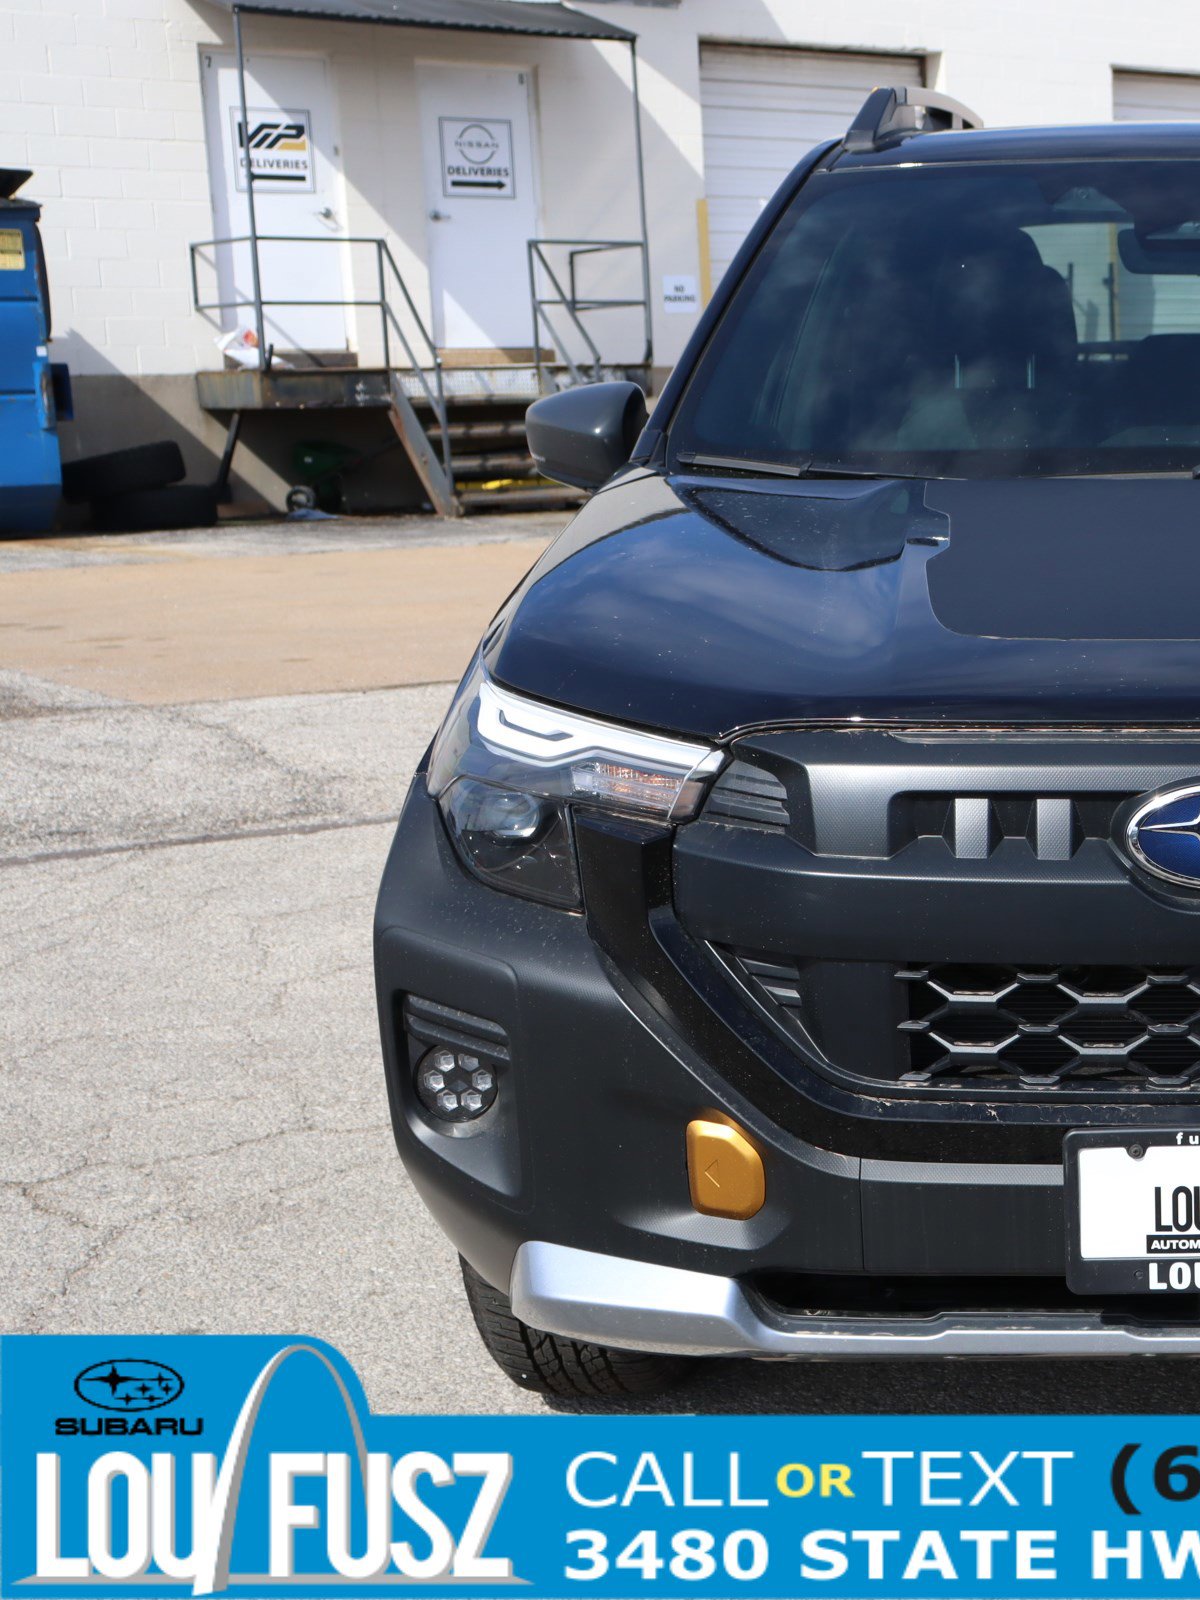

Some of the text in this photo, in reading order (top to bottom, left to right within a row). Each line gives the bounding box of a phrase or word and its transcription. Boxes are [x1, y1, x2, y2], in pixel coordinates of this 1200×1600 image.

[454, 140, 499, 149] NISSAN
[447, 165, 510, 177] DELIVERIES
[663, 294, 696, 303] PARKING
